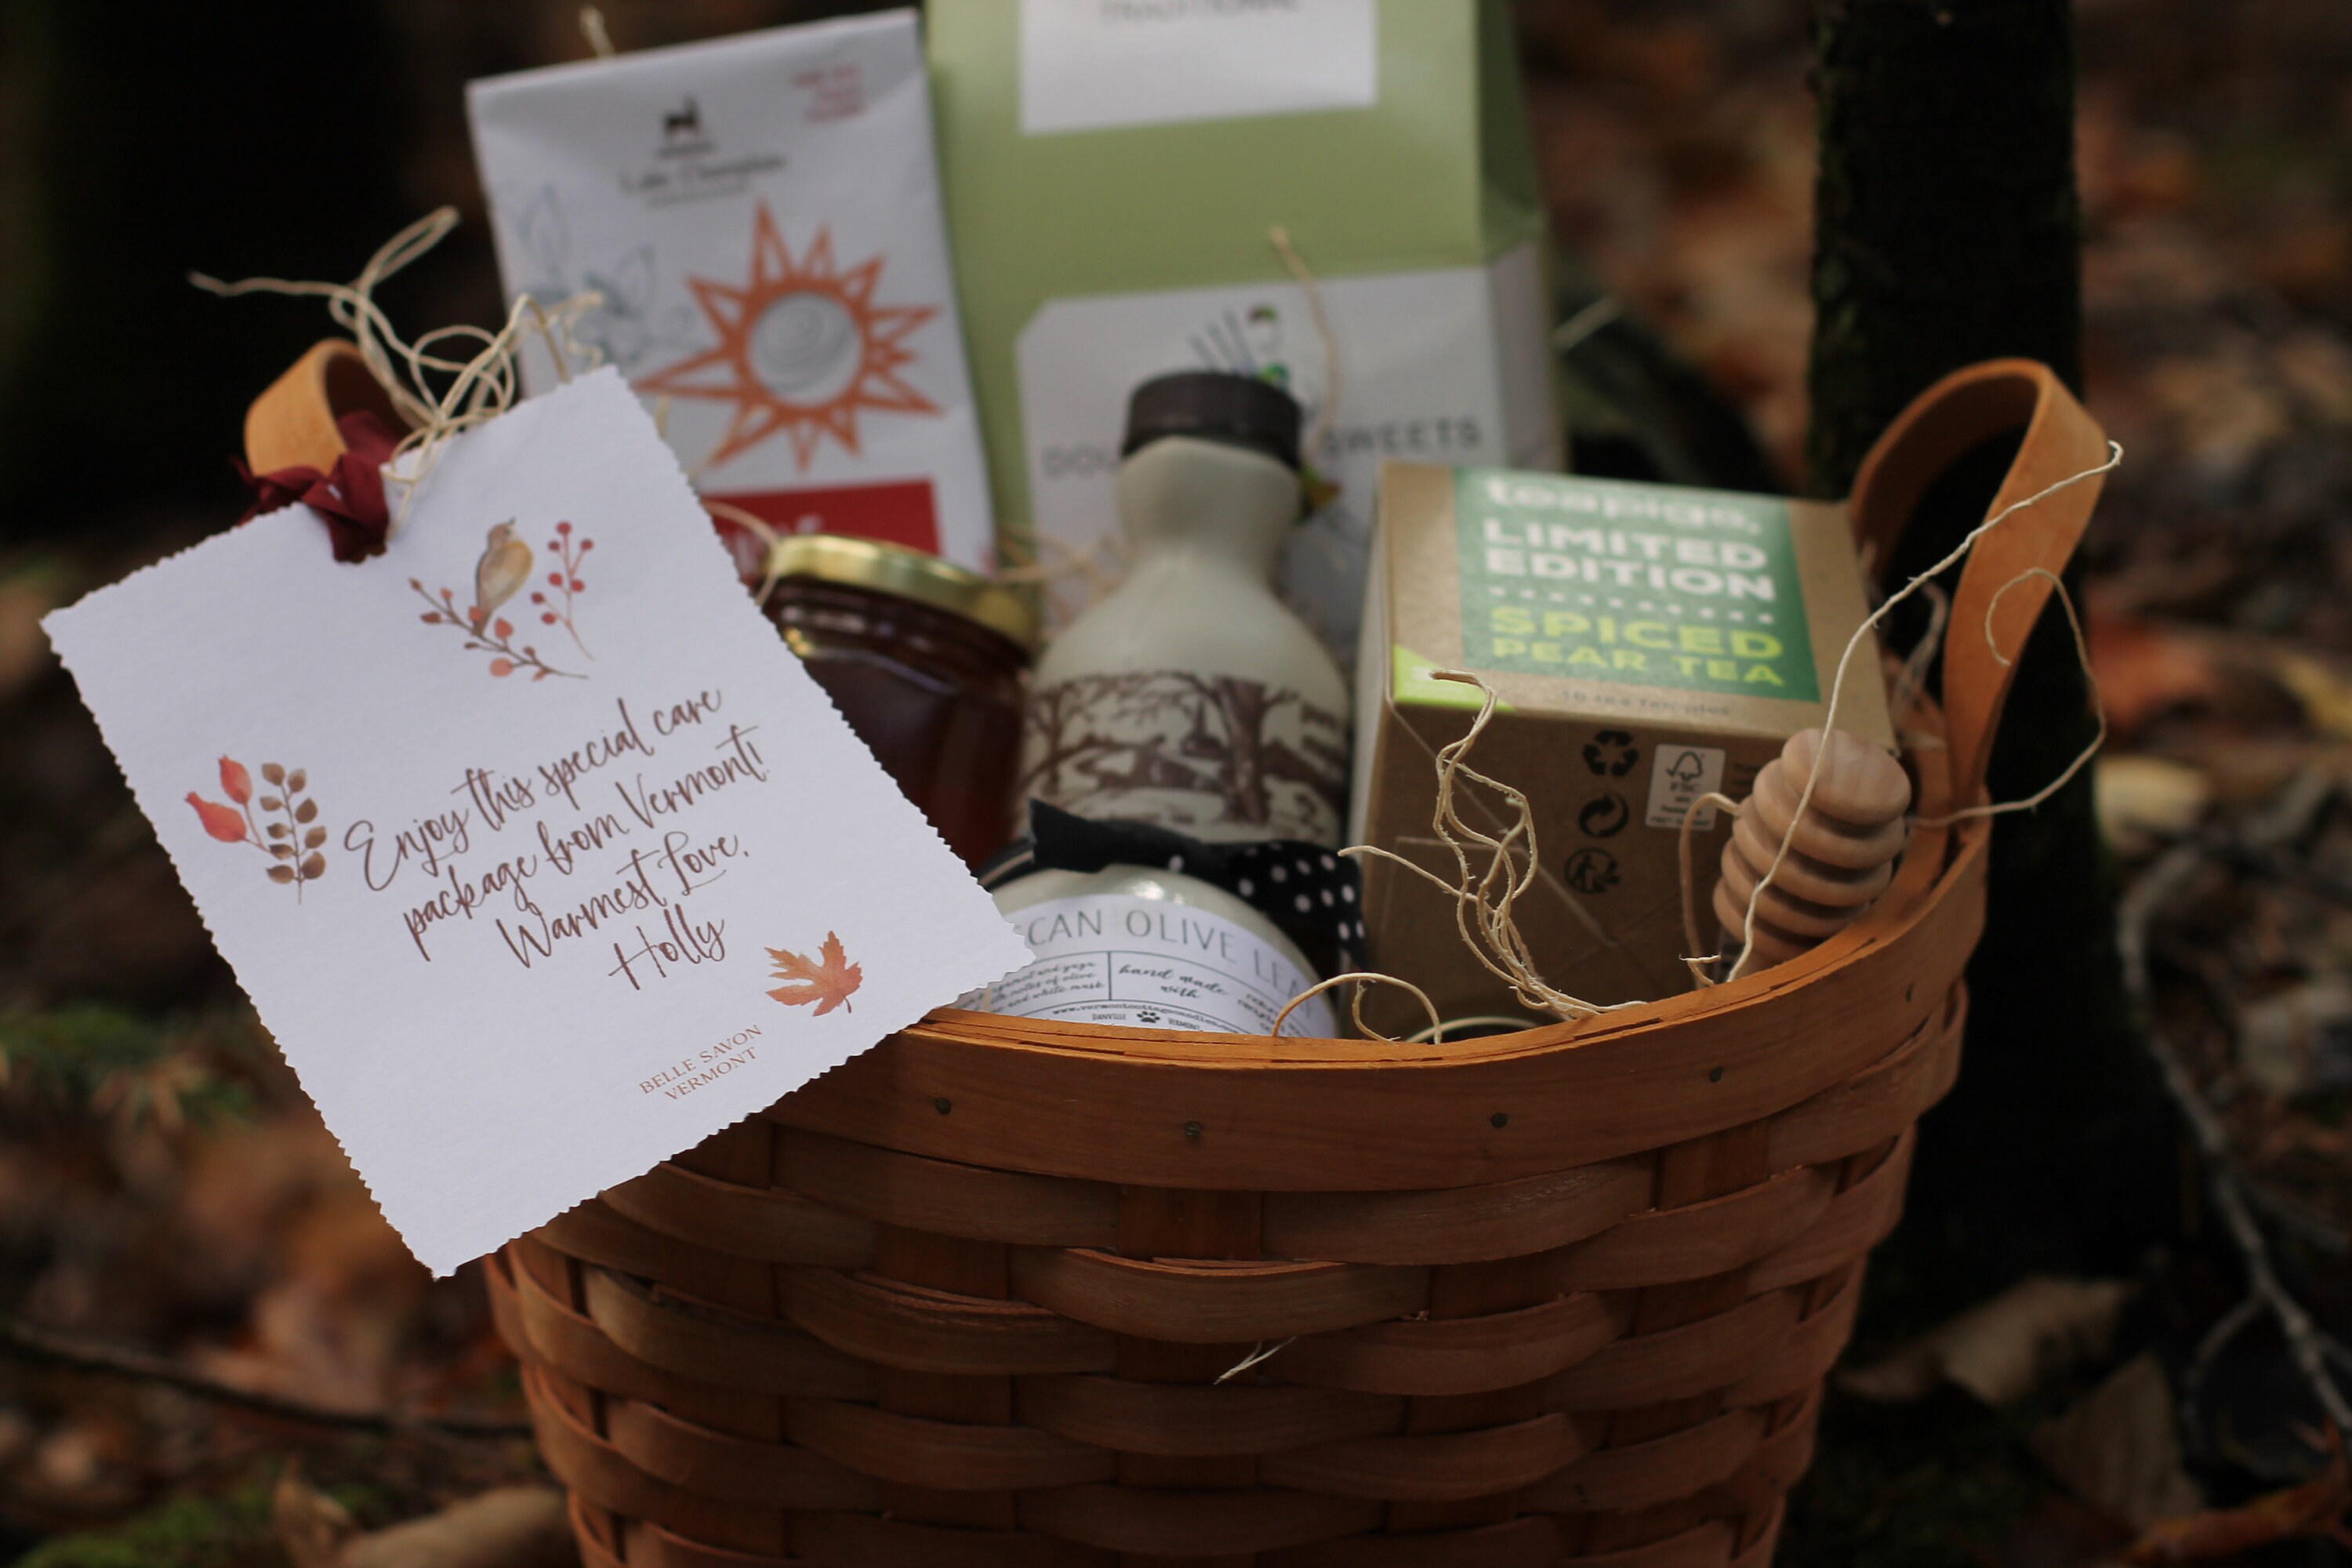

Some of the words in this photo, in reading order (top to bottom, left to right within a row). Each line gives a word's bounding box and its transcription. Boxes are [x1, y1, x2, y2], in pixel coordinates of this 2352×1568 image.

[1319, 416, 1483, 461] SWEETS
[1483, 518, 1768, 571] LIMITED
[1485, 547, 1777, 602] EDITION
[1490, 606, 1784, 660] SPICED
[1492, 637, 1648, 672] PEAR
[1671, 655, 1786, 687] TEA
[344, 809, 469, 891] Enjoy
[450, 768, 535, 831] this
[537, 697, 655, 811] special
[653, 689, 721, 736] care
[403, 854, 537, 963] package
[537, 815, 630, 876] from
[615, 724, 770, 829] Vermont!
[495, 849, 667, 969] Warmest
[608, 903, 725, 990] Holly
[1126, 909, 1237, 965] OLIVE
[1033, 985, 1067, 1000] white
[1070, 981, 1105, 992] musk
[1062, 971, 1097, 982] olive
[1119, 964, 1174, 980] hand
[1178, 974, 1229, 996] made
[1160, 984, 1201, 1000] with
[640, 1058, 696, 1094] BELLE
[699, 1024, 762, 1063] SAVON
[665, 1047, 757, 1100] VERMONT
